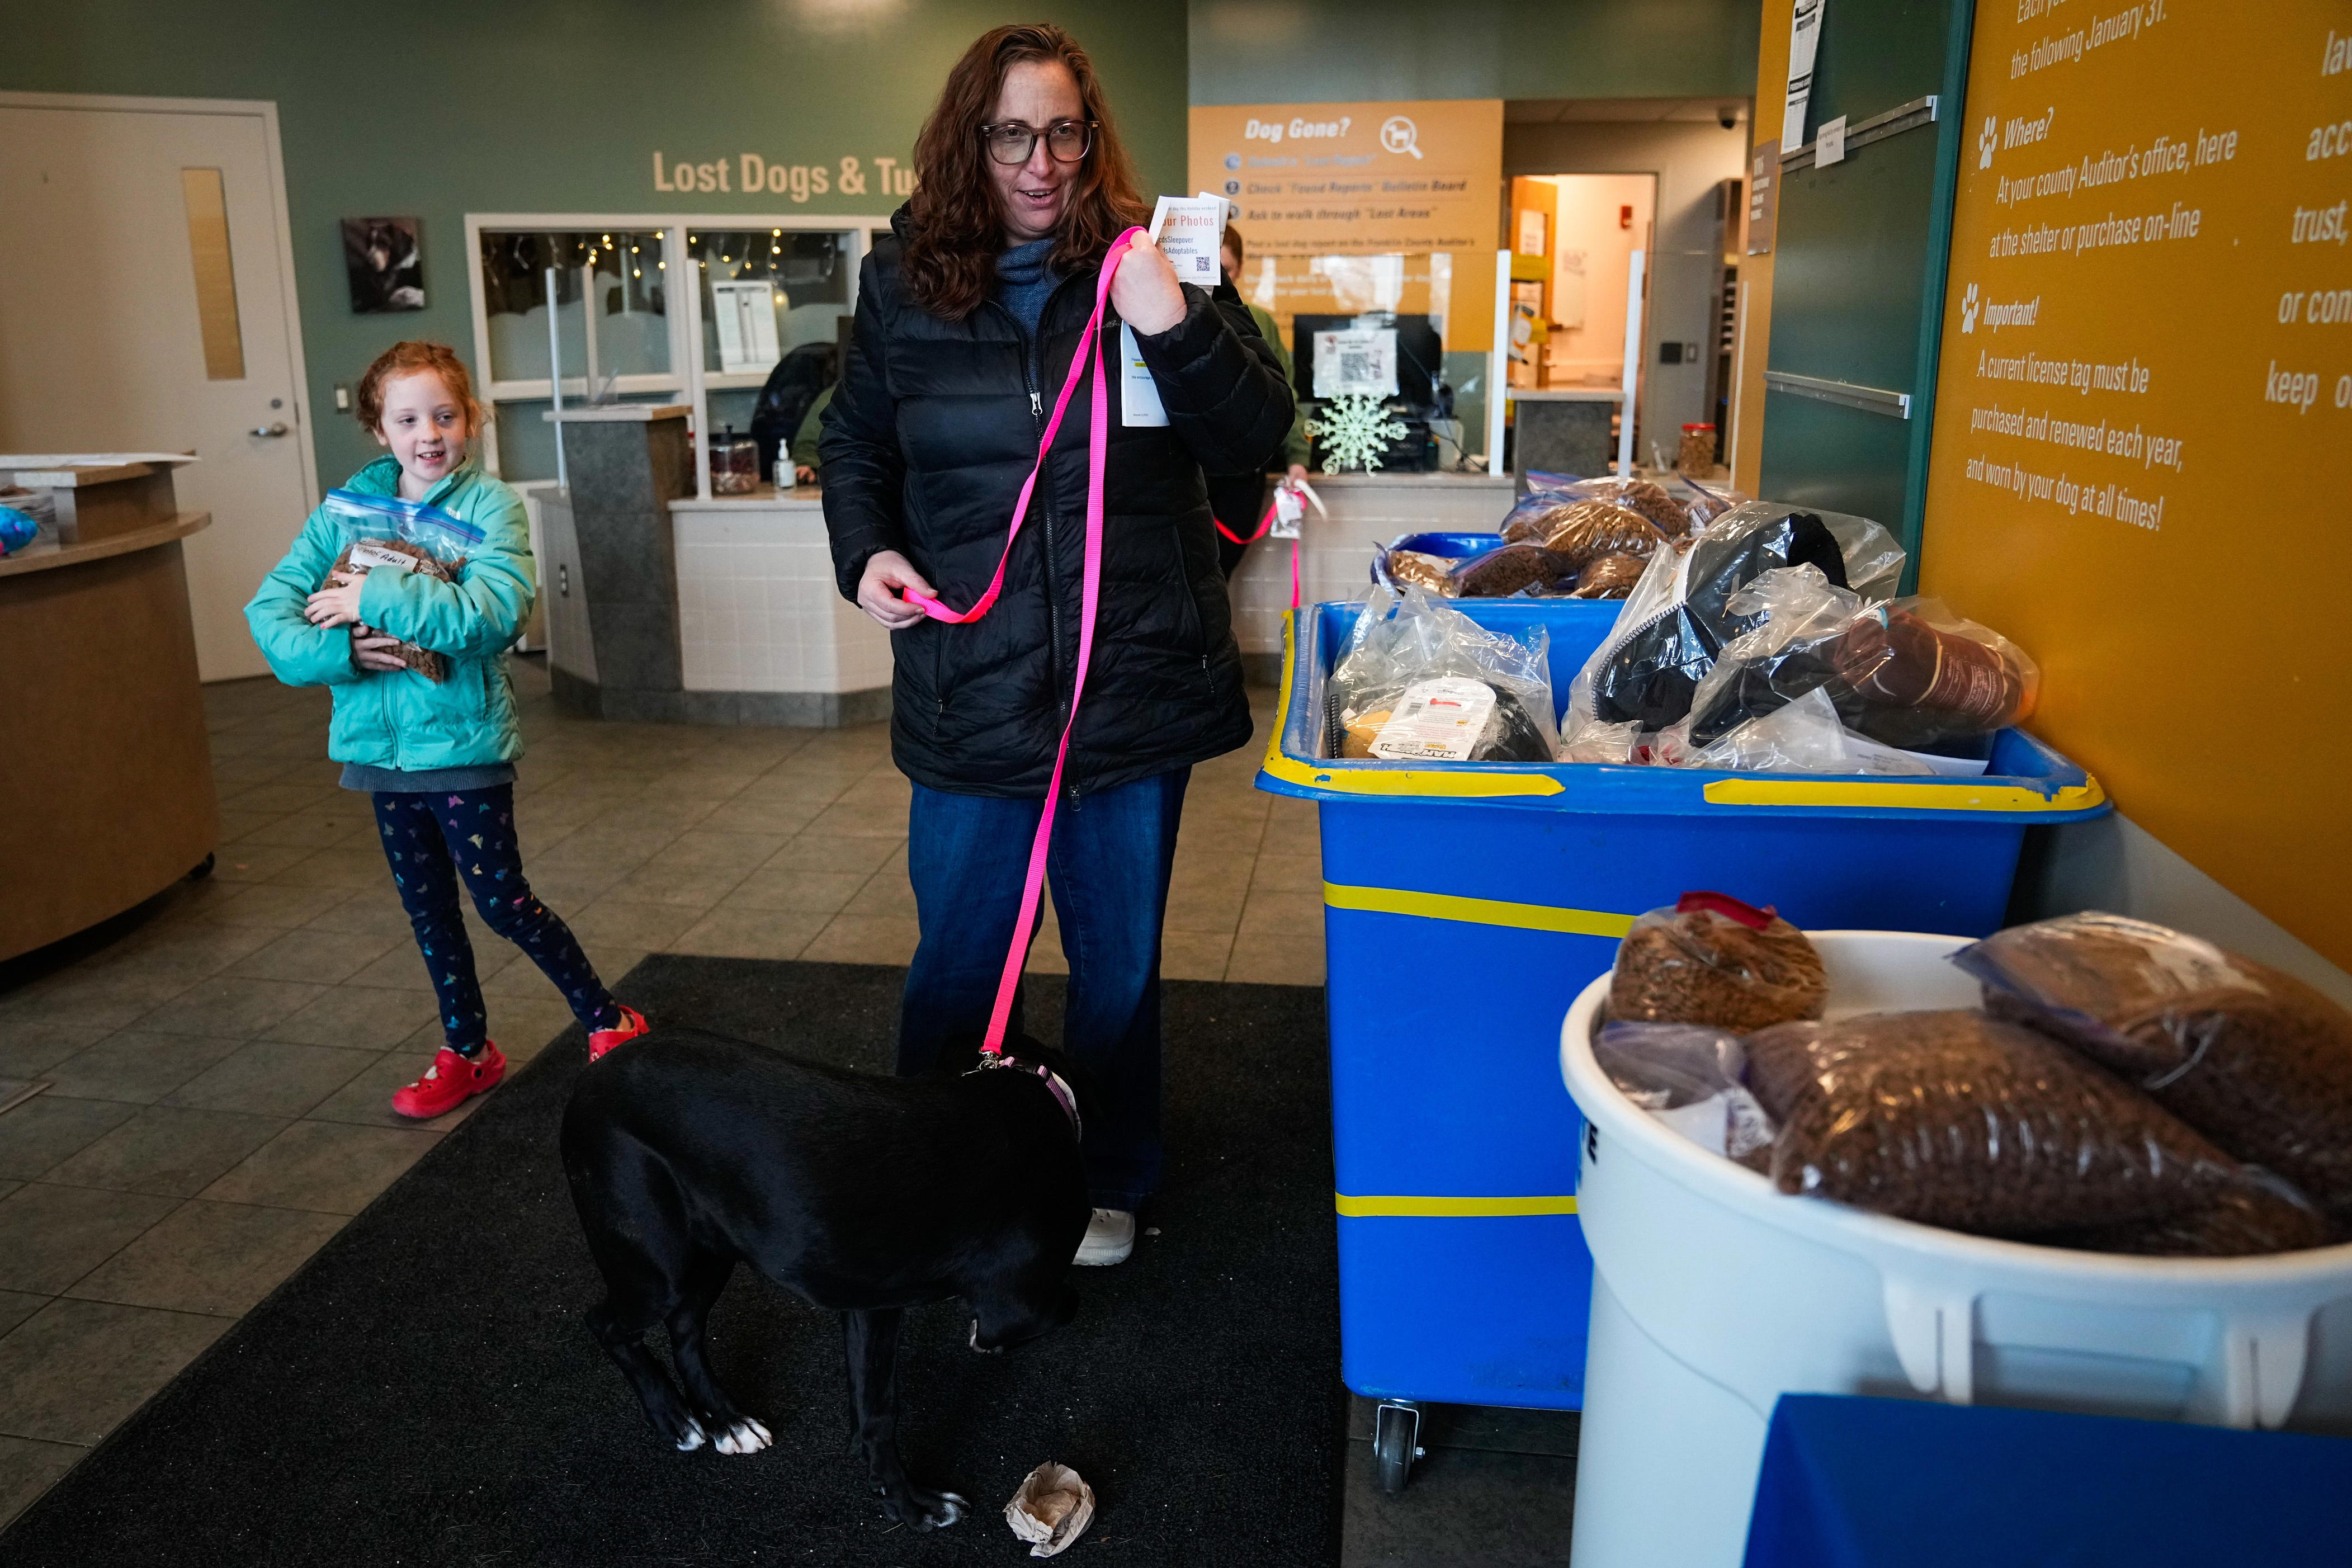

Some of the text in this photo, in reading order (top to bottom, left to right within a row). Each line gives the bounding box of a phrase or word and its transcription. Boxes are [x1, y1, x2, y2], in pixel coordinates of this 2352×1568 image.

[2011, 49, 2028, 79] the
[2030, 27, 2084, 72] following
[2085, 5, 2144, 51] January
[2146, 0, 2166, 27] 31.
[1245, 116, 1352, 143] Dog Gone?
[2004, 106, 2055, 150] Where?
[653, 151, 731, 192] Lost
[740, 153, 830, 203] Dogs
[839, 155, 867, 195] &
[1996, 129, 2238, 209] At your county Auditor's office, here
[1180, 215, 1214, 226] Photos
[1990, 201, 2201, 258] at the shelter or purchase on-line
[2292, 200, 2349, 245] trust,
[1983, 296, 2041, 334] Important!
[2278, 291, 2305, 324] or
[1976, 349, 2150, 395] A current license tag must be
[2265, 360, 2320, 415] keep
[1971, 404, 2183, 473] purchased and renewed each year,
[1967, 455, 2165, 531] and worn by your dog at all times!
[380, 554, 407, 565] Adult
